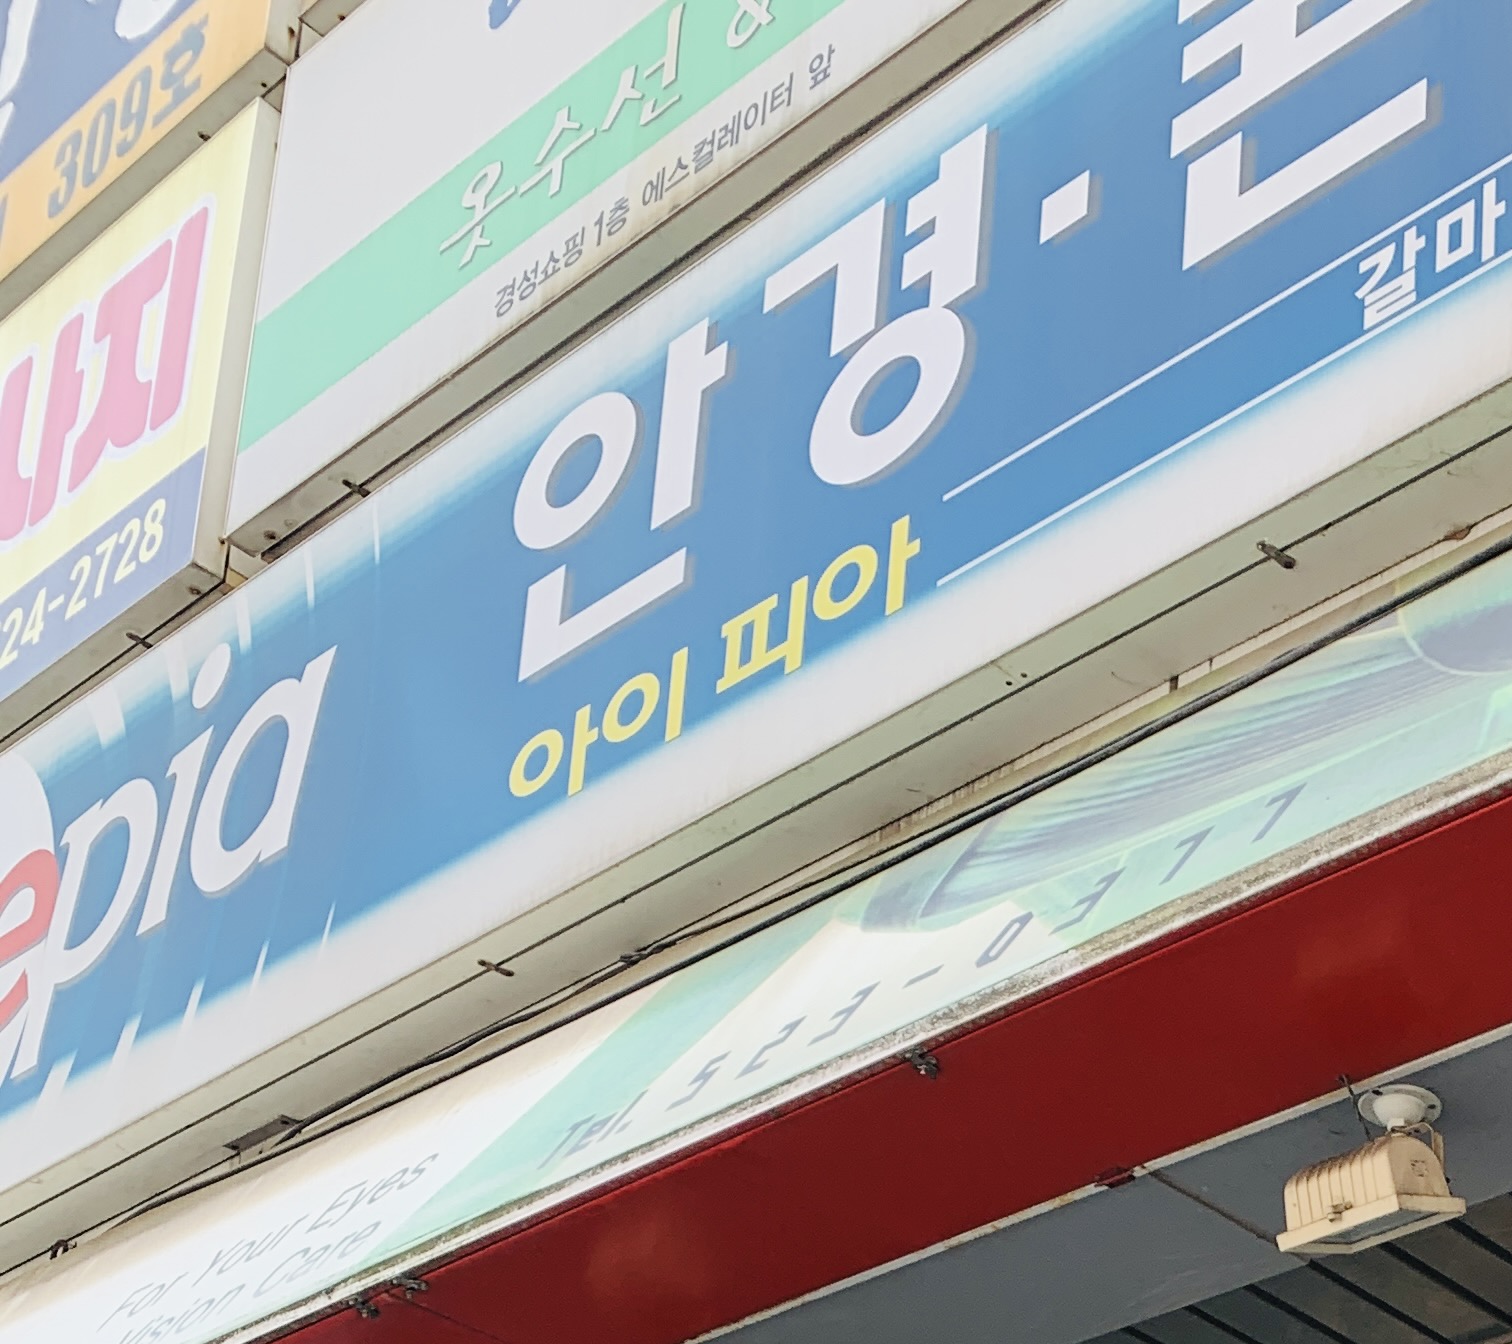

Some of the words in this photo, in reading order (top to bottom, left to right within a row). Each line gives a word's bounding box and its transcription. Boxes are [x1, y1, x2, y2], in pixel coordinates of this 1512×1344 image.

[47, 12, 208, 219] 309호
[437, 2, 687, 271] 옷수선
[493, 237, 586, 318] 경성쇼핑
[591, 196, 630, 257] 1층
[641, 73, 796, 212] 에스컬레이터
[806, 43, 838, 94] 앞
[0, 497, 167, 670] 24-2728
